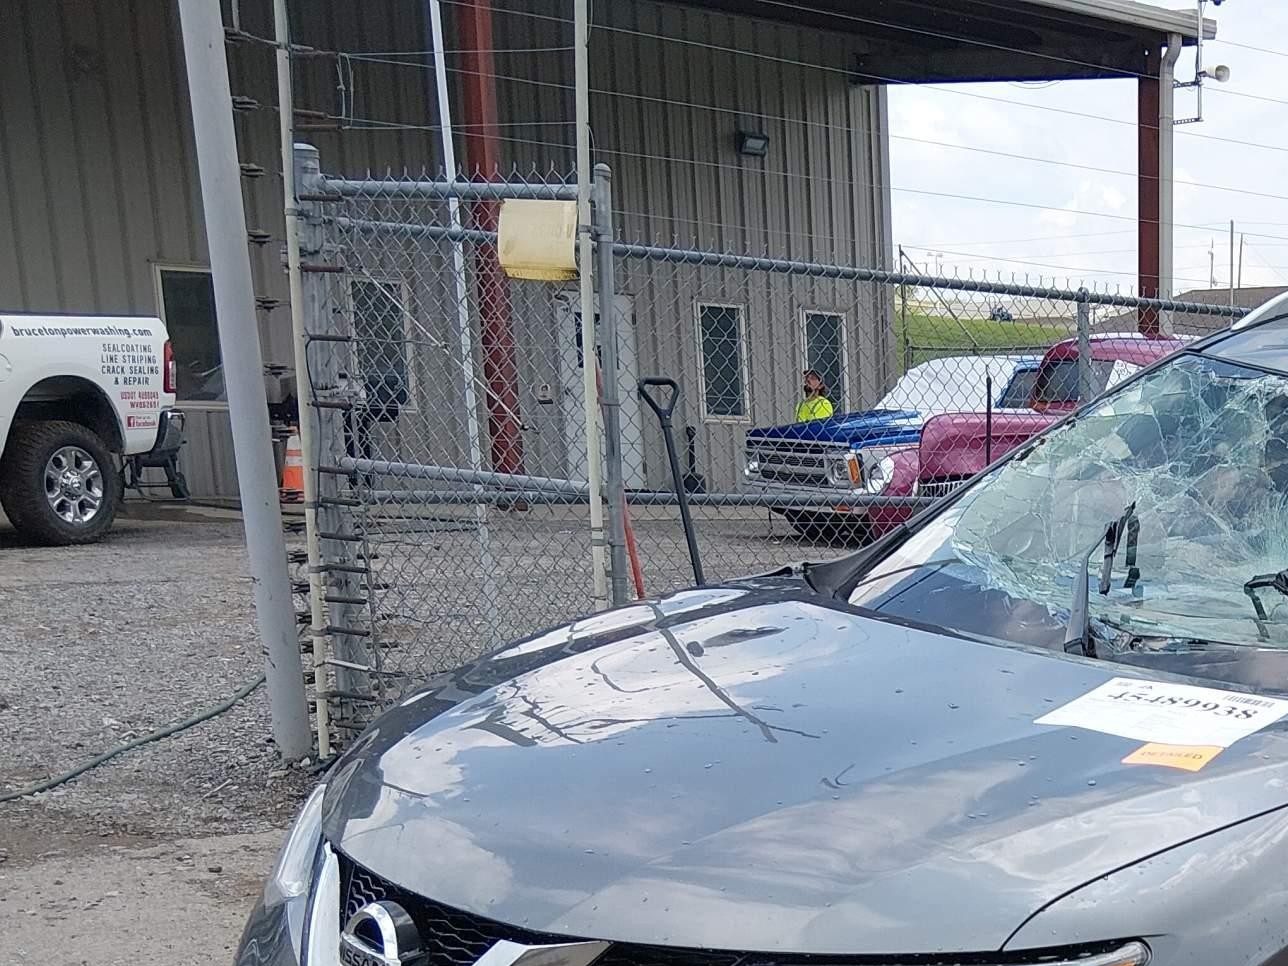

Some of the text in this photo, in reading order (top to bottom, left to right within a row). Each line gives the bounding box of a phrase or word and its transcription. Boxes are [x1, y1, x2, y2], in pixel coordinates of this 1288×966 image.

[11, 326, 153, 338] brucetonpowerwashing.com
[102, 343, 152, 353] SEALCOATING
[101, 354, 157, 364] LINE STRIPING
[101, 365, 159, 375] CRACK SEALING
[114, 377, 150, 386] & REPAIR
[1108, 691, 1258, 720] 45489938
